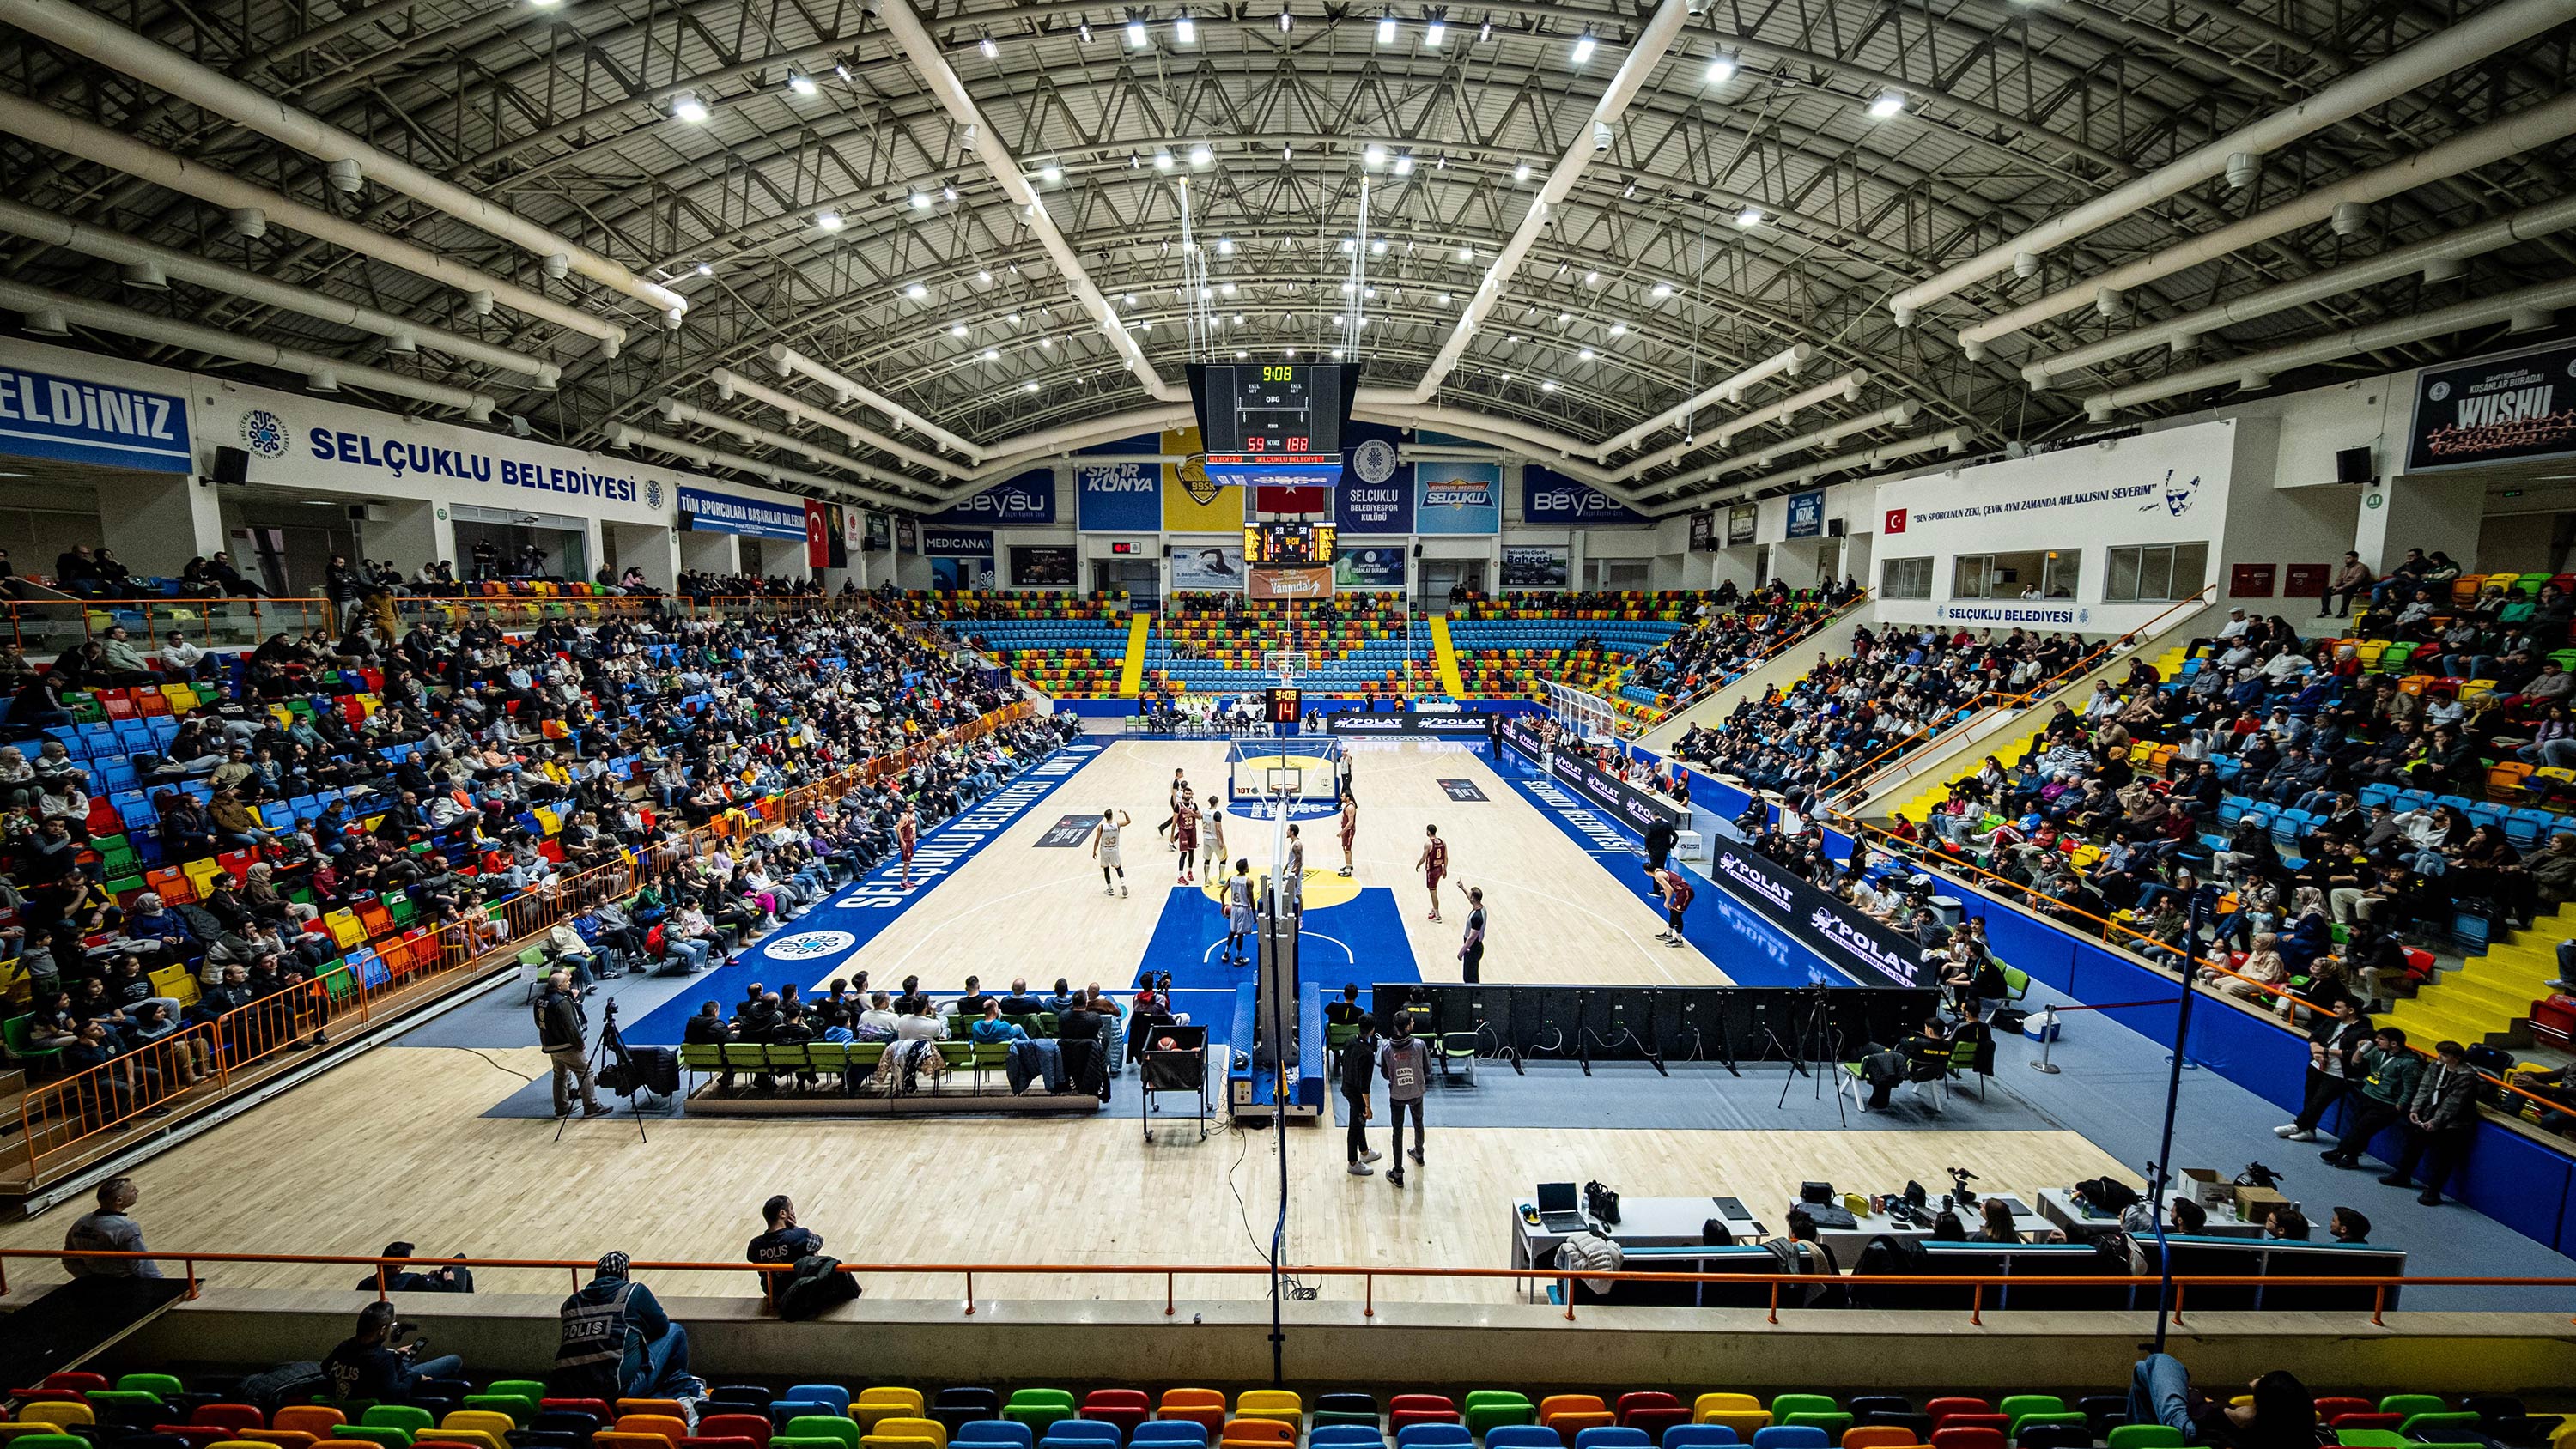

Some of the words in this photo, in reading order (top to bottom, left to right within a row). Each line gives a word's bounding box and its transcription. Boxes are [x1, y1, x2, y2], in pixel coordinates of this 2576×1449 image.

[1263, 367, 1292, 381] 9:08
[2470, 380, 2507, 394] KOŞANLAR
[2509, 373, 2544, 388] BURADA!
[2458, 385, 2554, 430] WUSHU
[1248, 437, 1264, 452] 59
[1285, 437, 1308, 452] 188
[309, 427, 492, 477] SELÇUKLU
[501, 460, 637, 502] BELEDİYESİ
[1087, 472, 1154, 492] KONYA
[1350, 489, 1399, 504] SELÇUKLU
[1427, 492, 1487, 505] SELÇUKLU
[1928, 508, 1963, 521] SPORCUNUN
[1984, 504, 2002, 517] ÇEVİK
[2004, 501, 2020, 512] AYNI
[2021, 497, 2057, 511] ZAMANDA
[2058, 490, 2109, 506] AHLAKLISINI
[681, 494, 700, 513] TÜM
[701, 500, 747, 520] SPORCULARA
[748, 506, 782, 524] BAŞARILAR
[1361, 512, 1388, 521] KULÜBÜ
[927, 538, 985, 549] MEDICANA
[1948, 608, 2002, 622] SELÇUKLU
[2005, 608, 2073, 623] BELEDİYESİ
[1275, 690, 1297, 700] 9:08
[1279, 702, 1293, 720] 14
[1523, 735, 1539, 749] POLAT
[1562, 759, 1583, 777] POLAT
[1622, 772, 1628, 782] 2
[1594, 779, 1619, 798] POLAT
[835, 834, 986, 908] SELÇUKLU
[949, 780, 1055, 830] BELEDİYESİ
[1030, 755, 1089, 776] KONYA
[1105, 836, 1116, 846] 33
[1740, 863, 1794, 902] POLAT
[1838, 922, 1919, 978] POLAT
